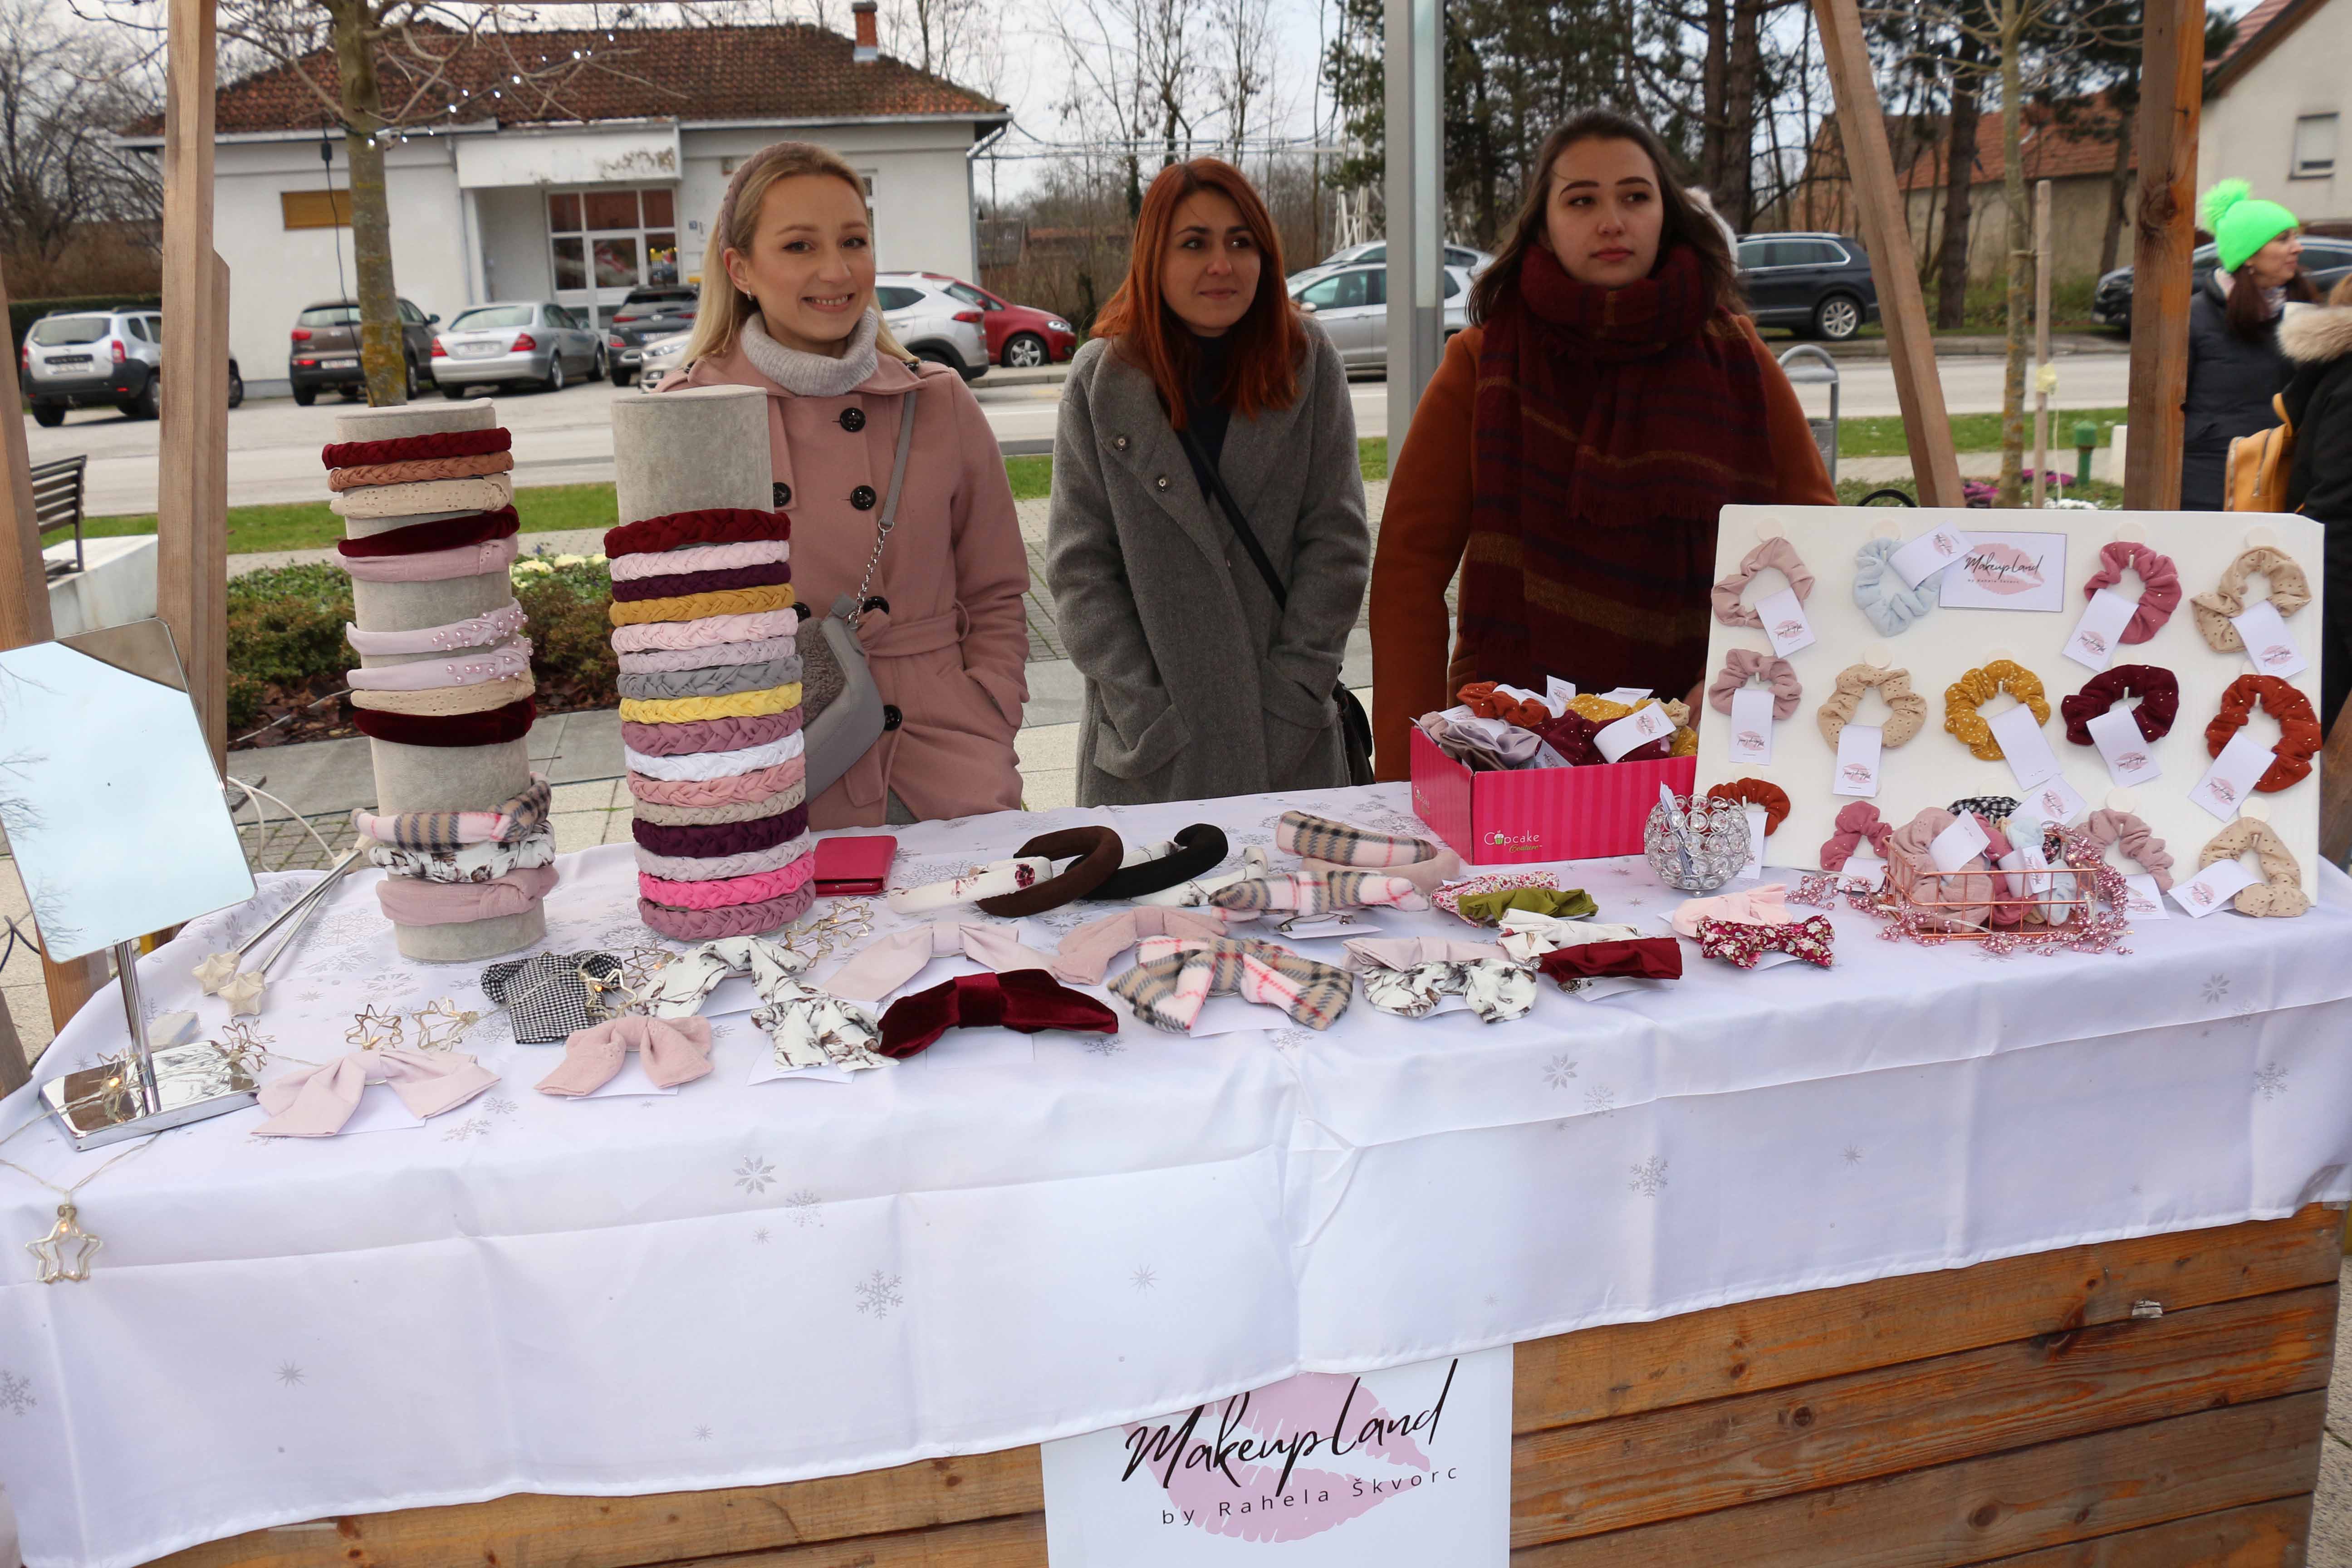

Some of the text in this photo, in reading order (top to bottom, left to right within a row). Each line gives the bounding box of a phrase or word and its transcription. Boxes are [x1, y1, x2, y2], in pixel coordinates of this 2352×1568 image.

[1162, 1468, 1456, 1526] by Rahela Škvorc
